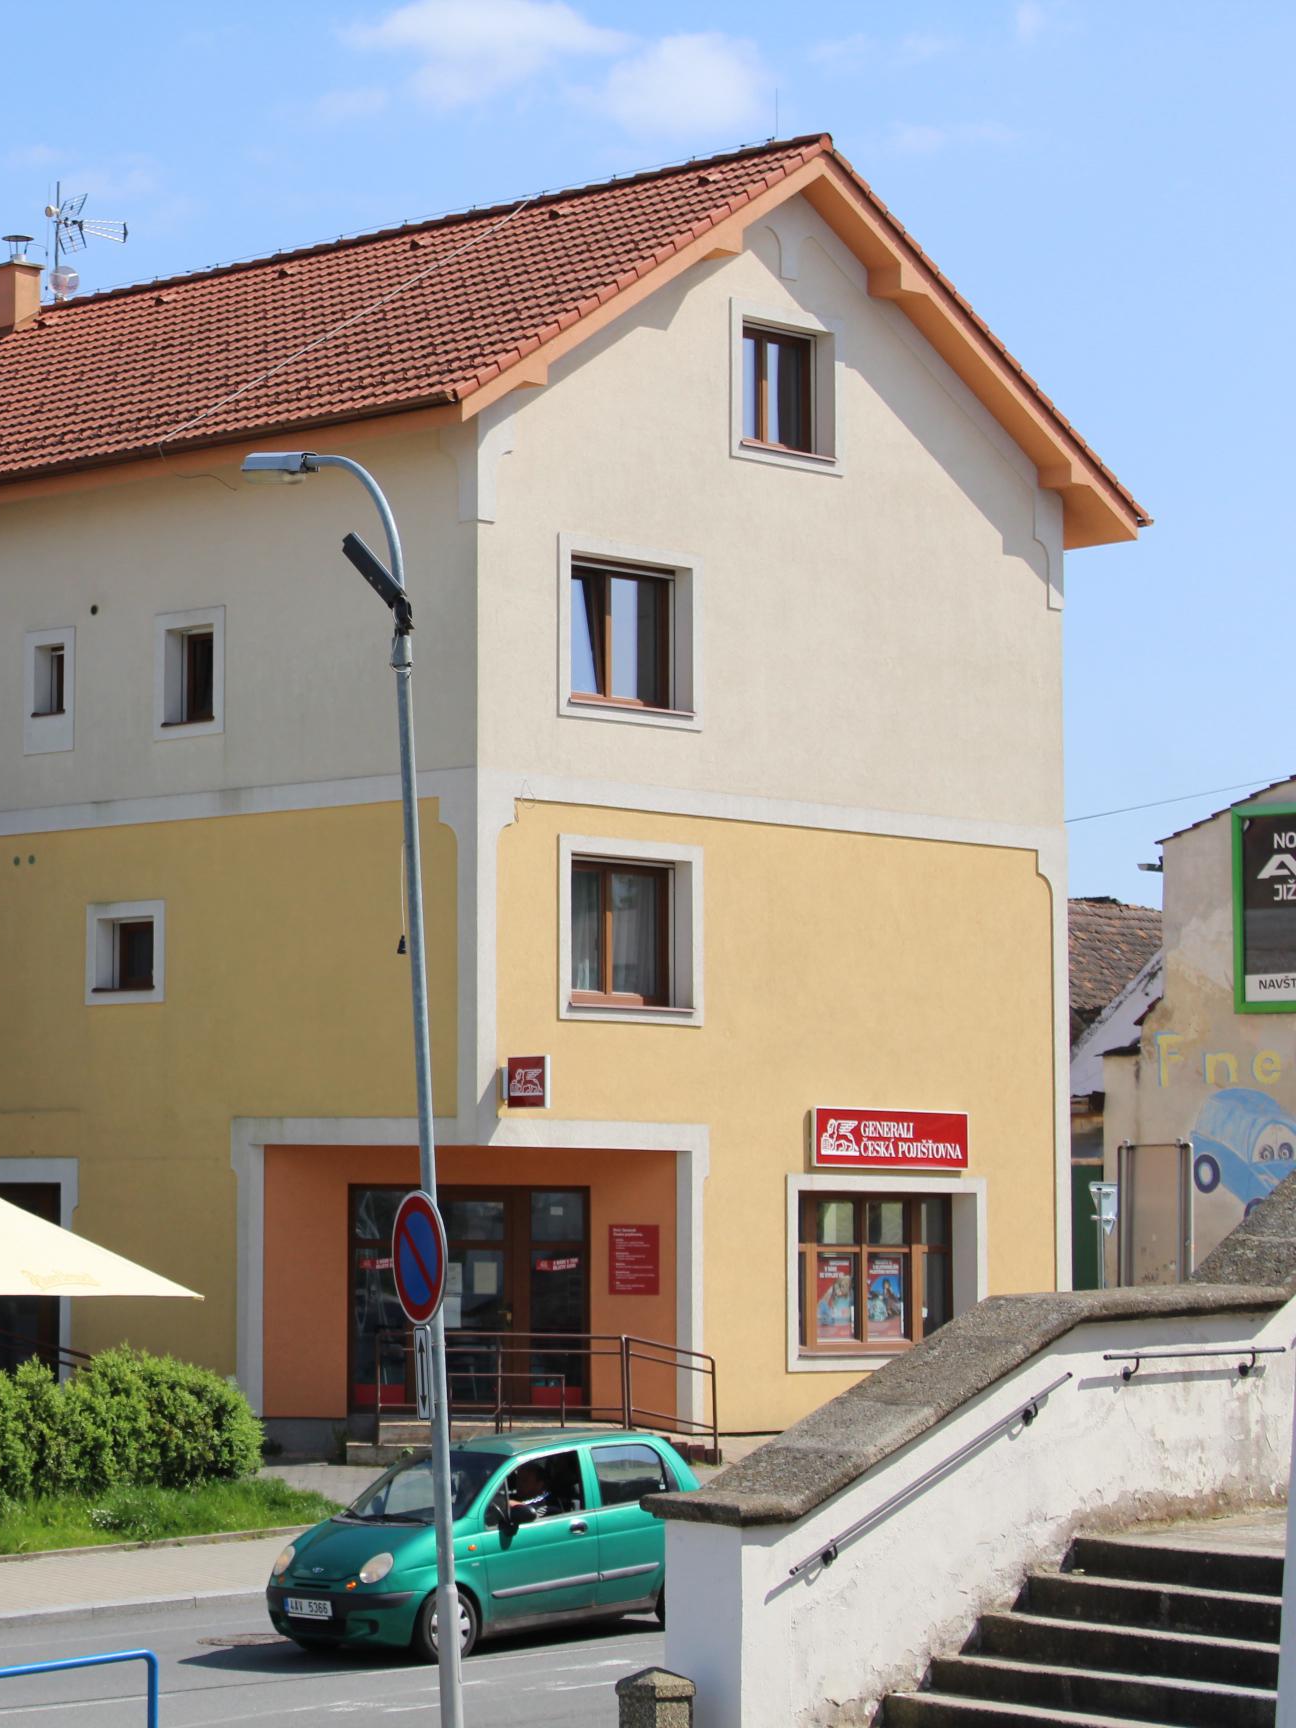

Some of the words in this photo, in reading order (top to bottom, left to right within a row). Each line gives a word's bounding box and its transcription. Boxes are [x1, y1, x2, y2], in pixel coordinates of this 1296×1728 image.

[860, 1120, 914, 1138] GENERALI
[860, 1138, 896, 1157] ČESKÁ
[898, 1139, 963, 1159] POJIŠŤOVNA
